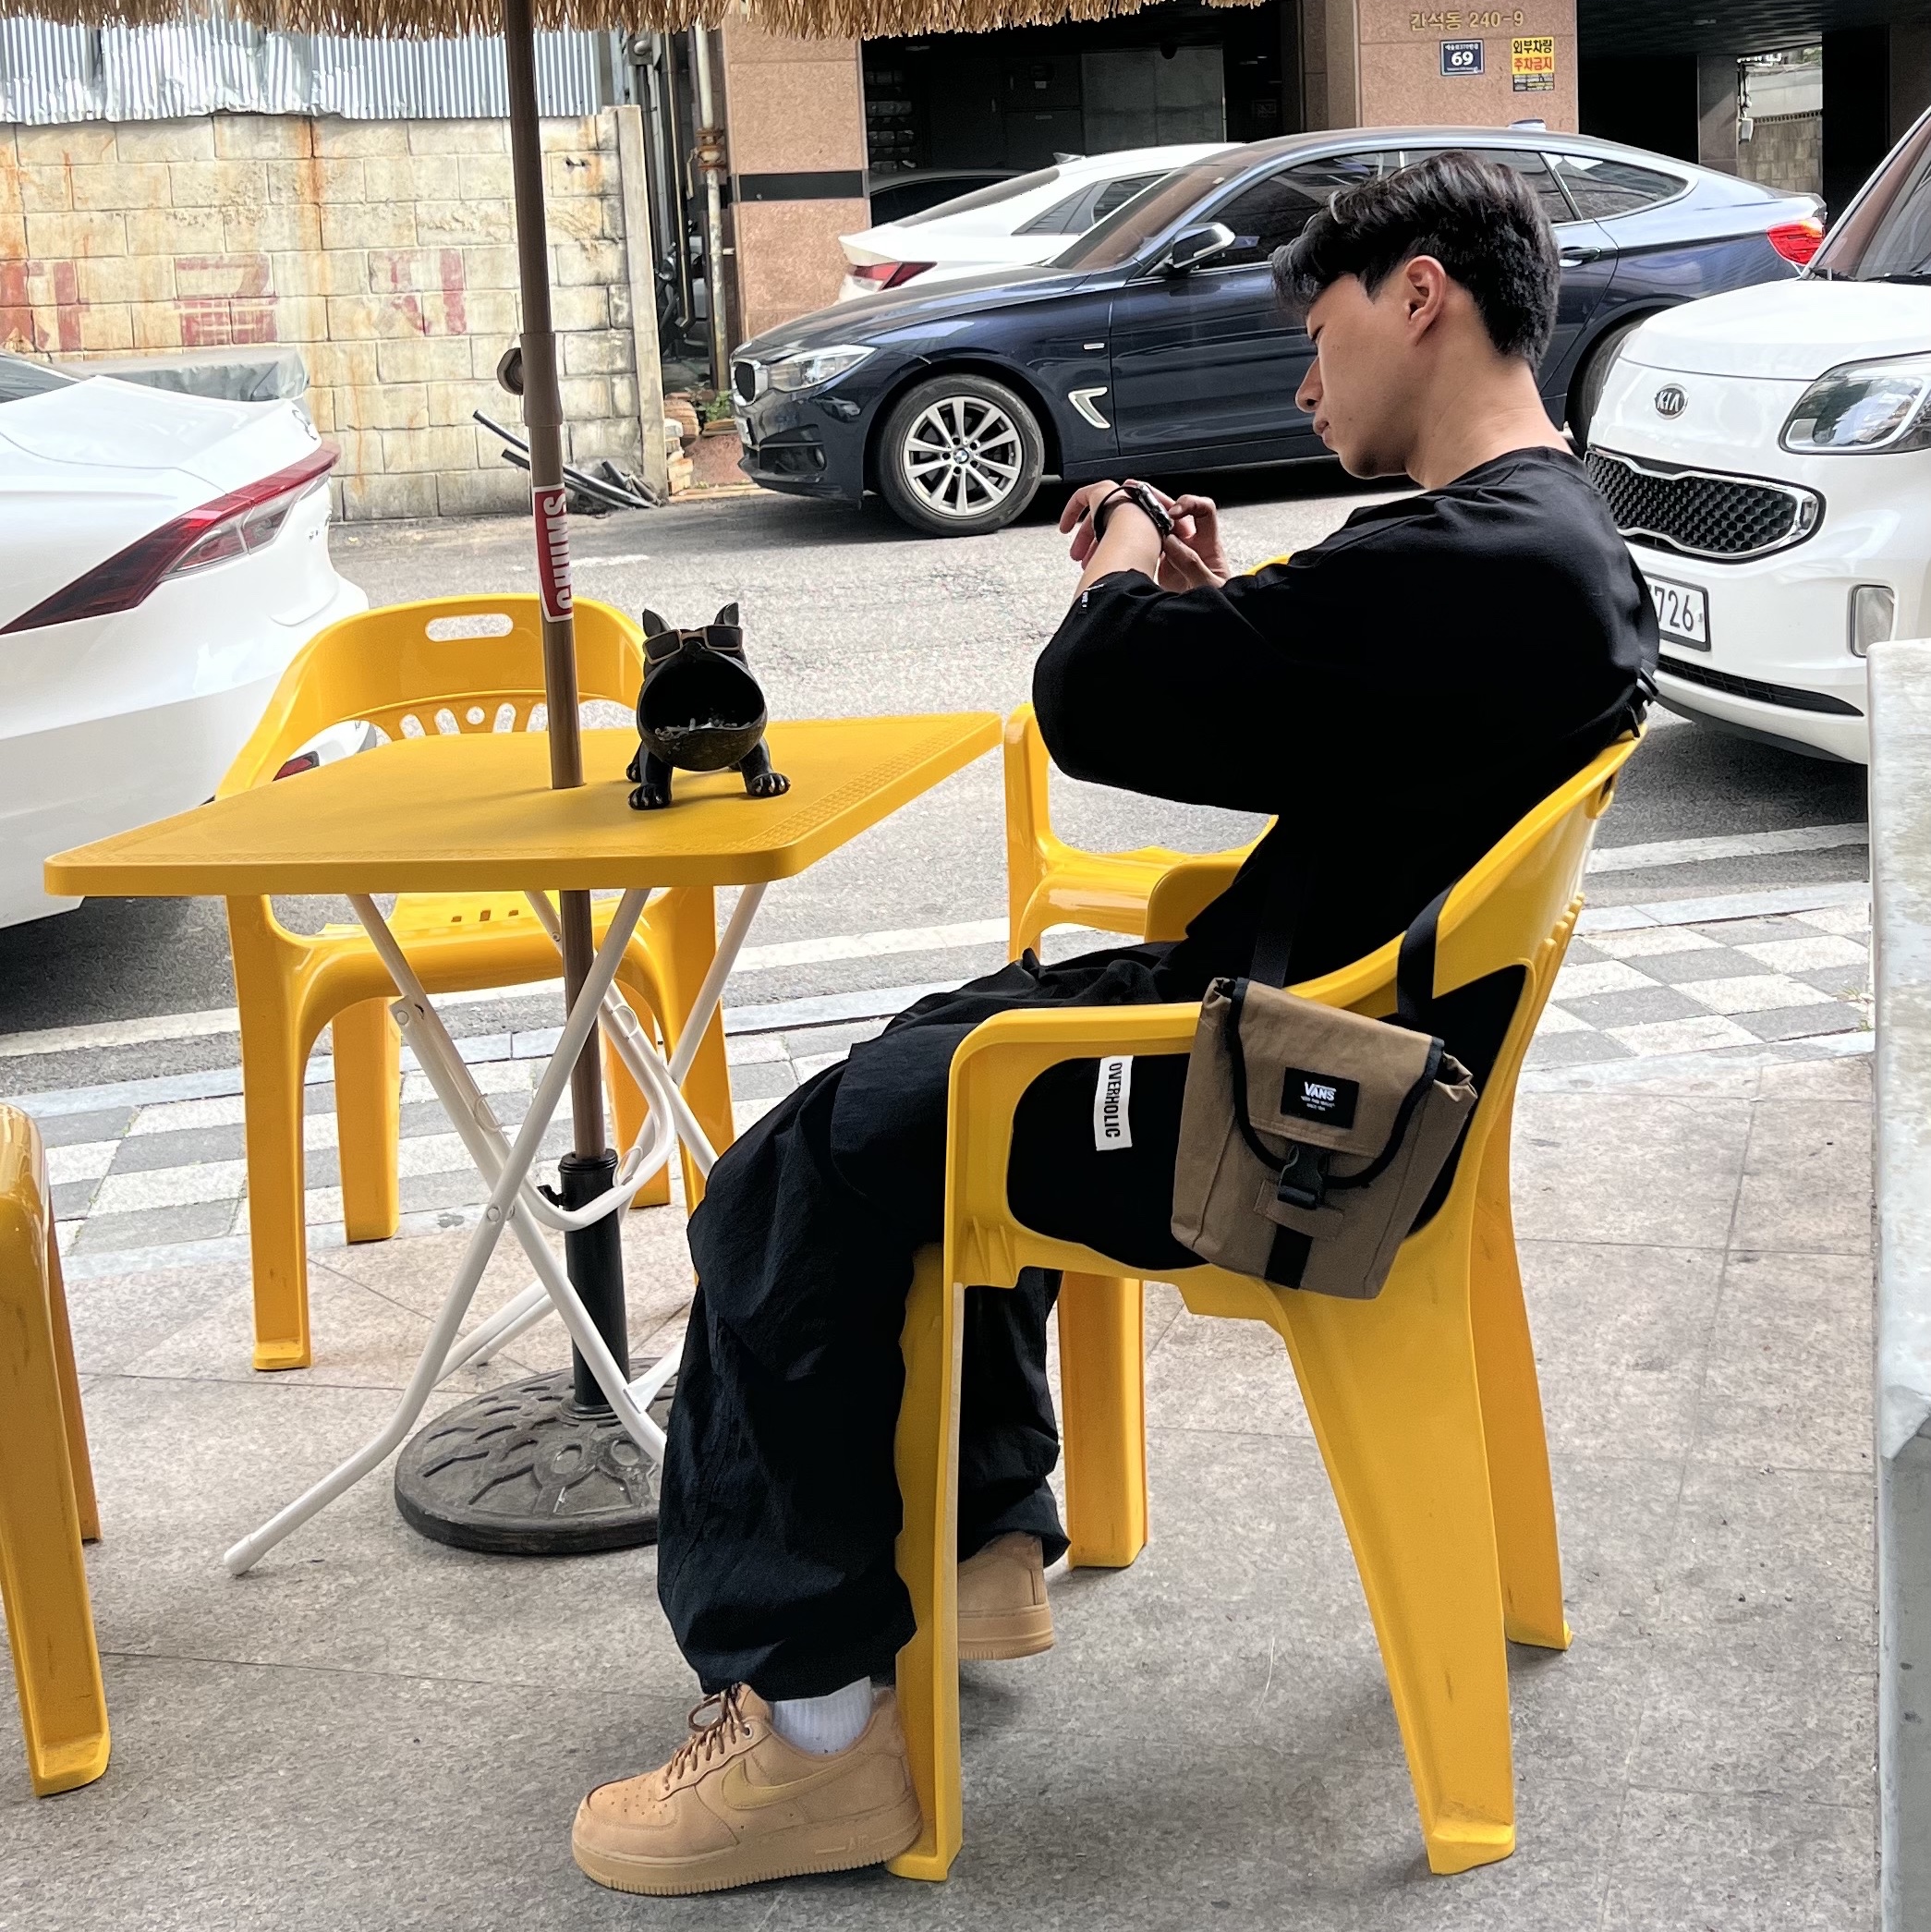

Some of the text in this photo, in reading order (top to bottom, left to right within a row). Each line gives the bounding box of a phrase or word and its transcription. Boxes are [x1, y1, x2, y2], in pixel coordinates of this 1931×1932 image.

[1410, 10, 1524, 31] 간석동 240-9
[1512, 39, 1552, 55] 외부차량
[1451, 51, 1474, 67] 69
[1513, 56, 1552, 72] 주차금지
[1657, 391, 1681, 412] KIA
[1647, 583, 1694, 632] 726
[1103, 1062, 1123, 1138] OVERHOLIC
[1304, 1081, 1337, 1101] VANS
